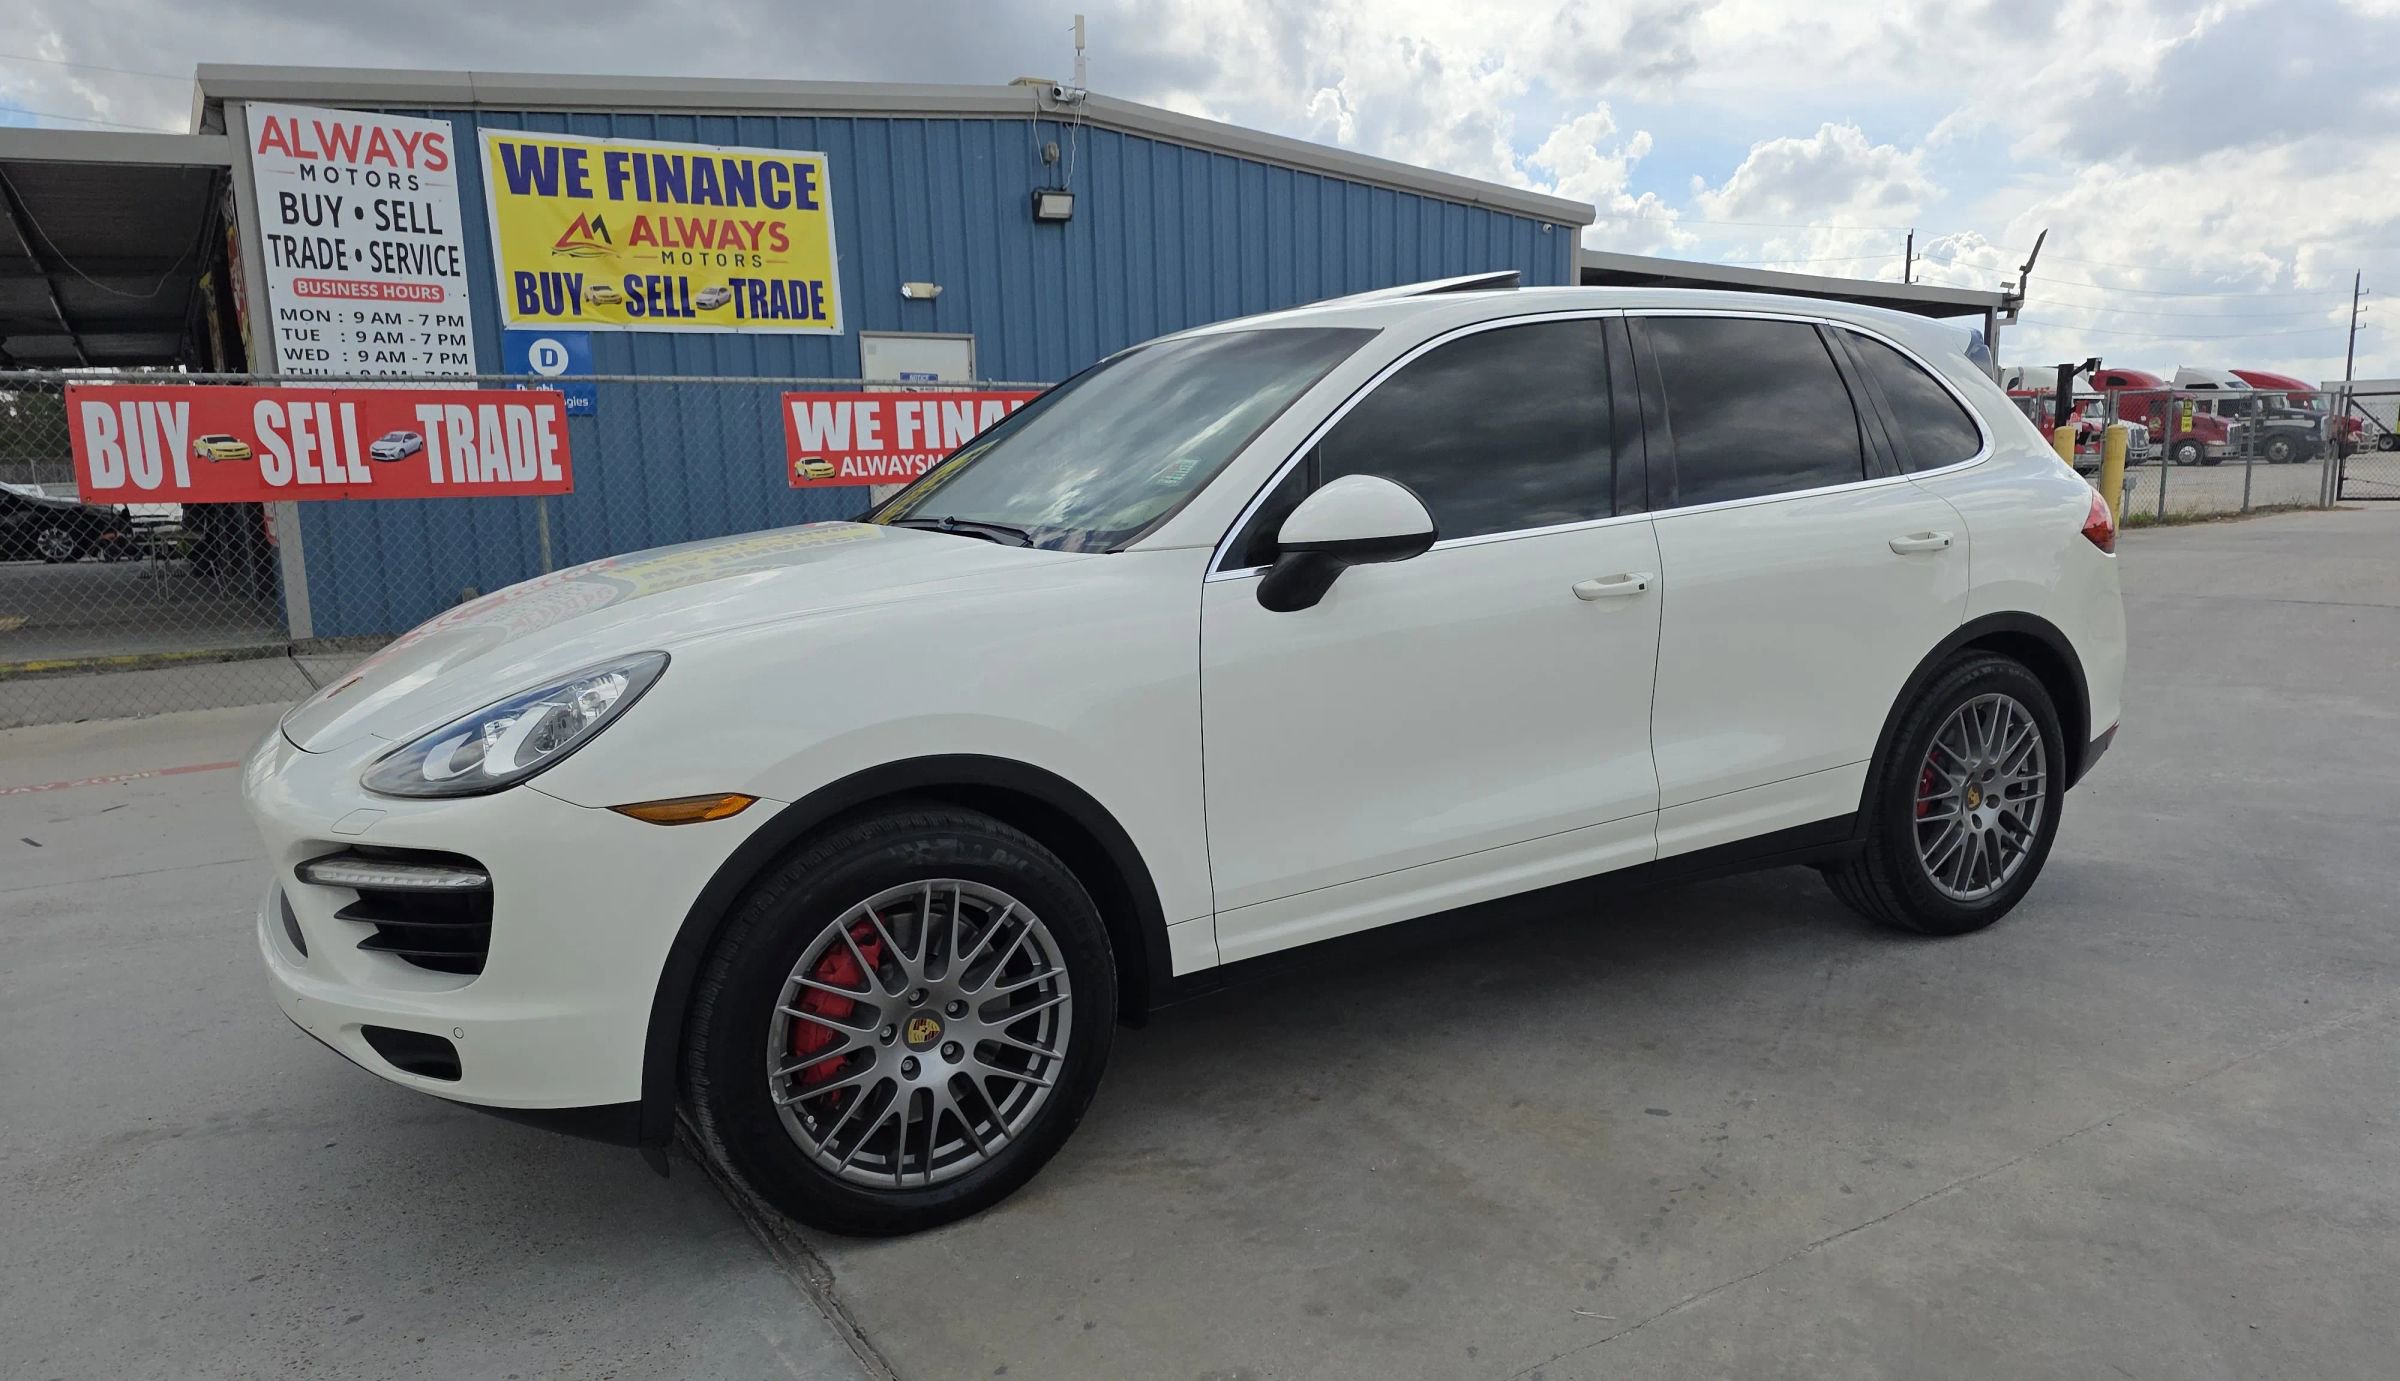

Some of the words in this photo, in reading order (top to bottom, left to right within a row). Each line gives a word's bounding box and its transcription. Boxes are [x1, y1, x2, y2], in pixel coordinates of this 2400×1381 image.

[258, 115, 449, 172] ALWAYS
[299, 164, 419, 191] MOTORS
[498, 143, 594, 198] WE
[603, 151, 819, 211] FINANCE
[278, 191, 343, 228] BUY
[373, 199, 443, 235] SELL
[628, 214, 790, 253] ALWAYS
[267, 233, 349, 271] TRADE
[369, 240, 461, 277] SERVICE
[661, 251, 763, 268] MOTORS
[297, 280, 379, 297] BUSINESS
[383, 284, 441, 300] HOURS
[514, 271, 583, 316] BUY
[623, 273, 696, 318] SELL
[728, 278, 826, 320] TRADE
[280, 308, 331, 323] MON
[353, 311, 365, 324] 9
[370, 312, 402, 325] AM
[418, 314, 430, 326] 7
[435, 315, 465, 328] PM
[281, 327, 321, 342] TUE
[355, 330, 367, 343] 9
[373, 331, 404, 345] AM
[420, 333, 432, 345] 7
[437, 333, 467, 346] PM
[283, 347, 331, 361] WED
[357, 350, 369, 363] 9
[375, 350, 406, 364] AM
[422, 352, 433, 364] 7
[439, 352, 468, 365] PM
[81, 401, 191, 490] BUY
[253, 400, 373, 487] SELL
[415, 404, 563, 484] TRADE
[790, 401, 884, 452] WE
[895, 399, 1025, 450] FINA
